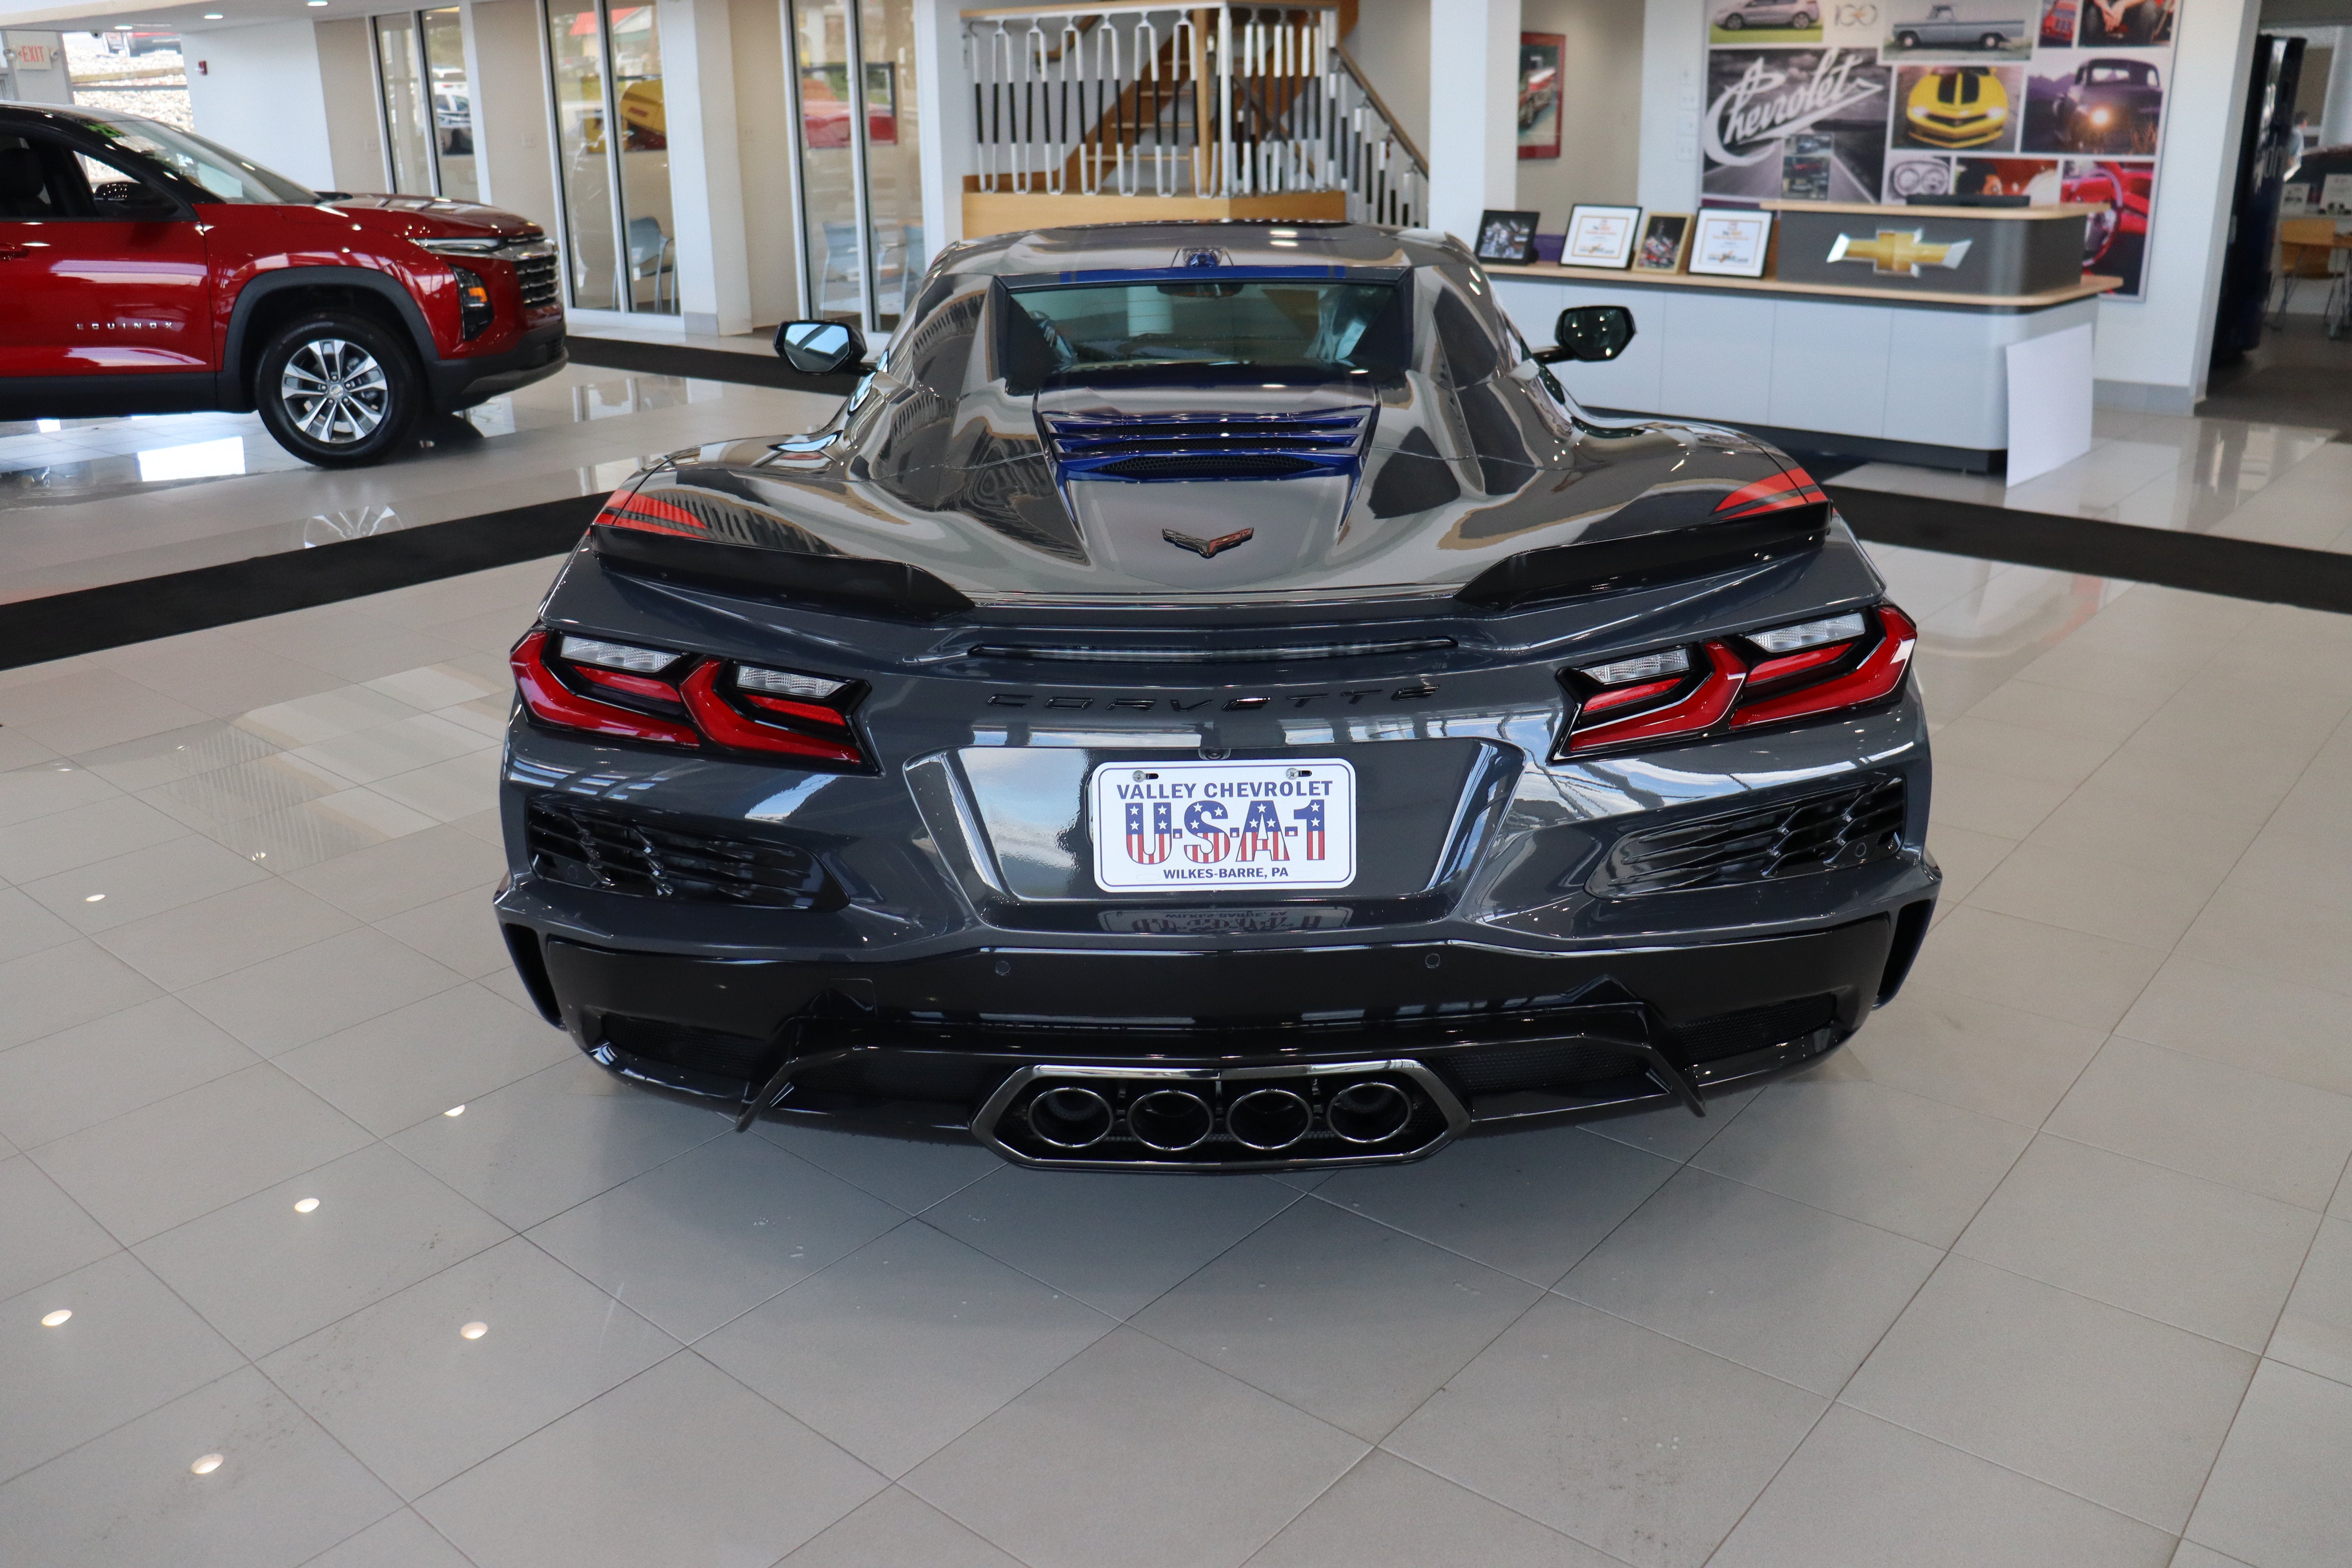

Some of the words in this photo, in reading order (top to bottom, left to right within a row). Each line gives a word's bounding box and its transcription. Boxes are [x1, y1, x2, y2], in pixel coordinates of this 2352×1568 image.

[21, 45, 44, 62] EXIT
[1702, 46, 1884, 167] Chevrolet
[76, 321, 173, 330] EQUINOX
[987, 684, 1440, 712] CORVETTE
[1116, 783, 1197, 800] VALLEY
[1204, 780, 1333, 798] CHEVROLET
[1163, 868, 1267, 879] WILKES-BARRE,
[1272, 867, 1289, 877] PA
